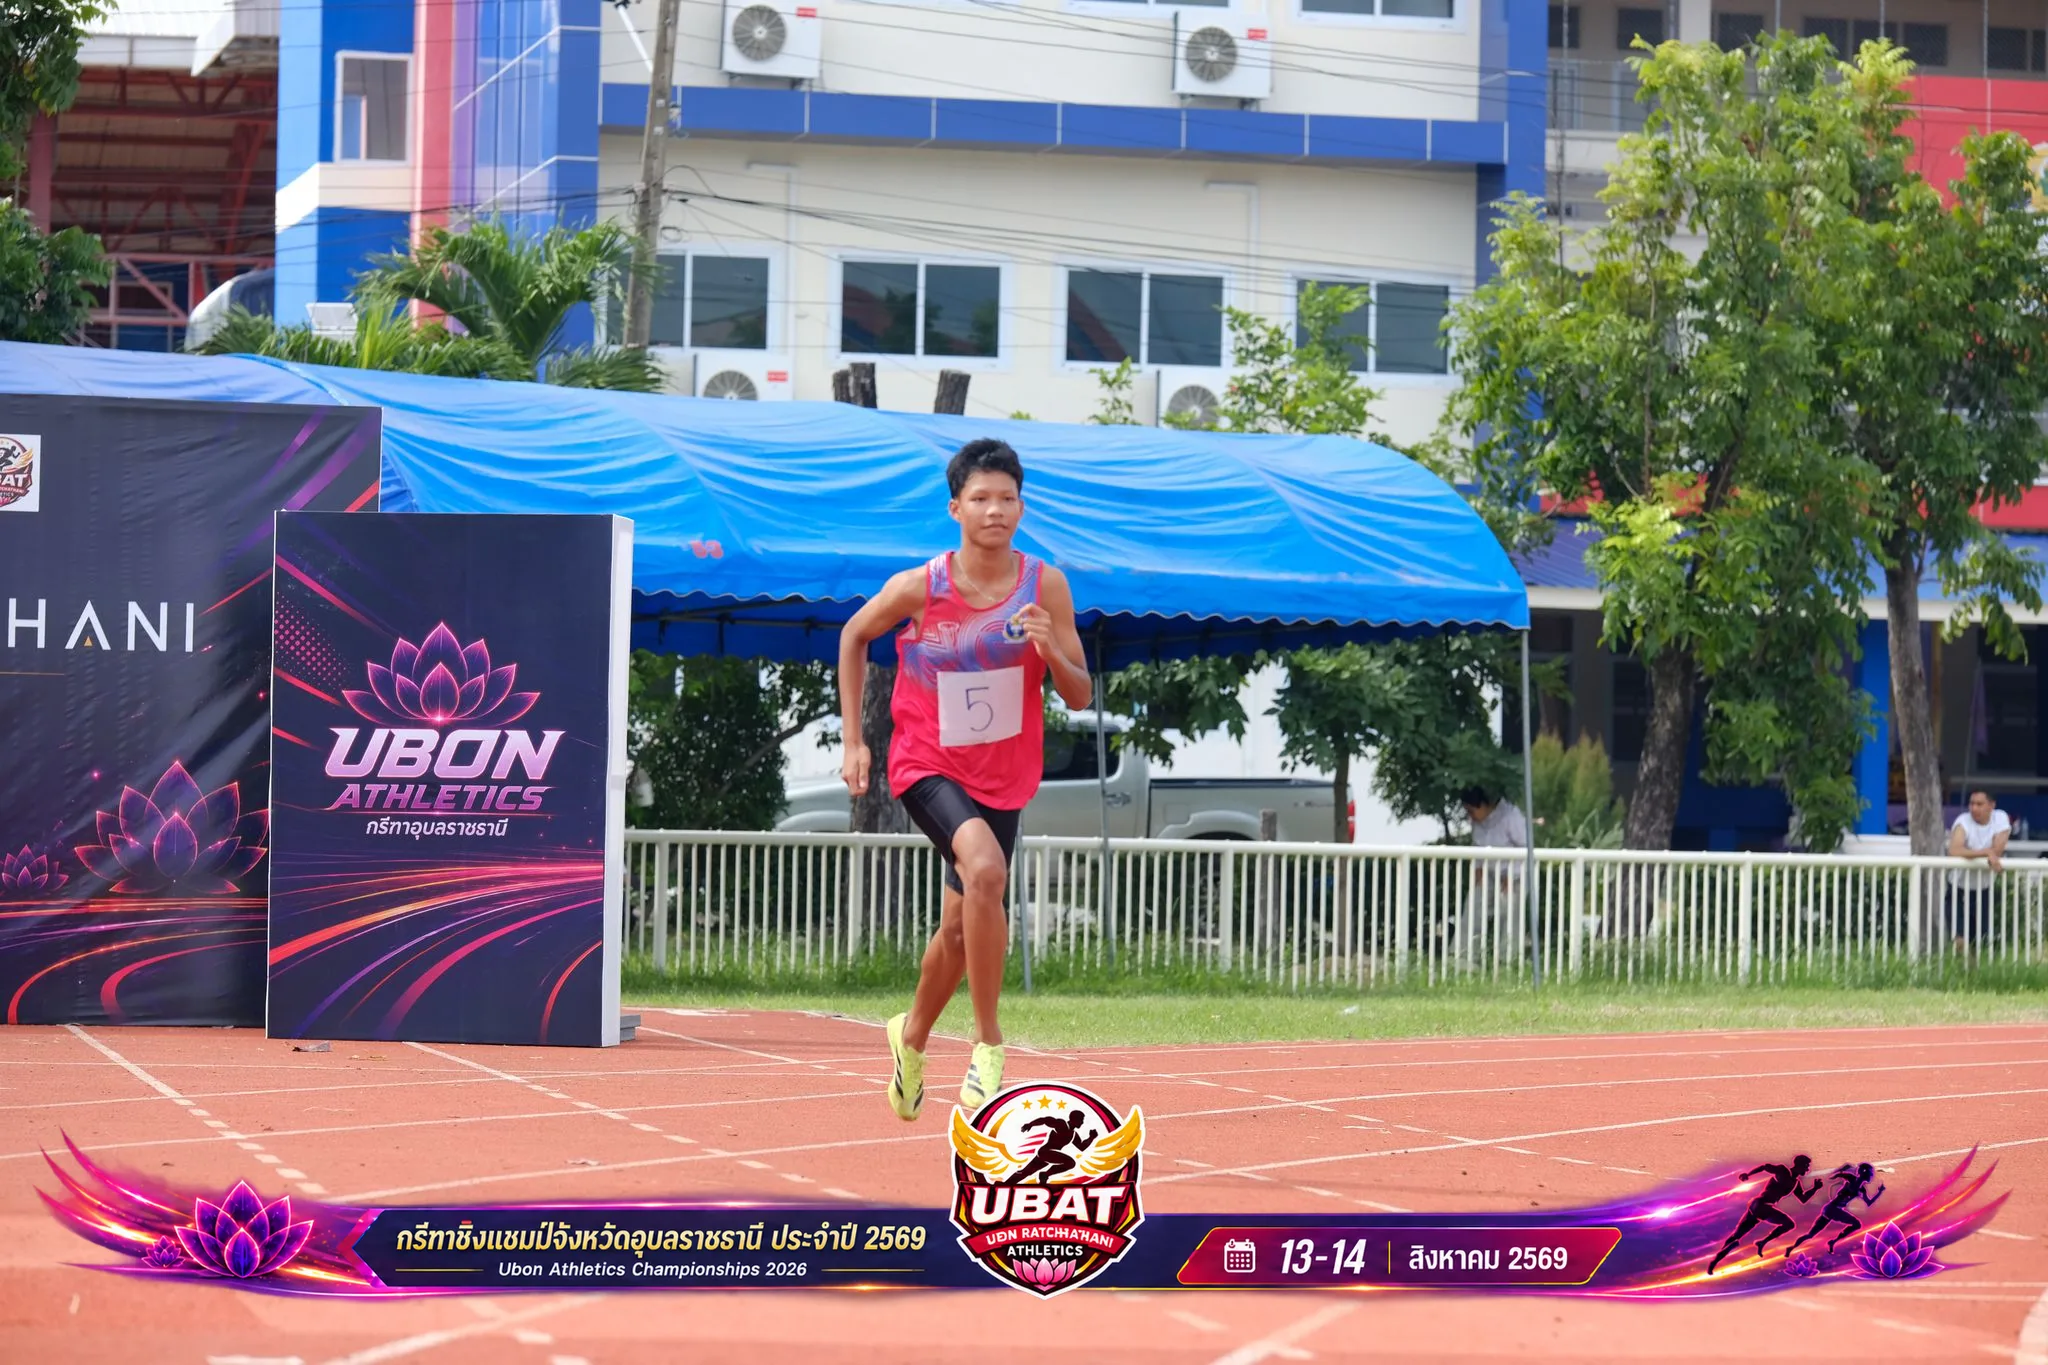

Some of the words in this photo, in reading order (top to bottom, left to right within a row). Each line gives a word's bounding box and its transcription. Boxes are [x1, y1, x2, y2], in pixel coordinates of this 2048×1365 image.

[0, 474, 28, 488] AT
[965, 686, 994, 732] 5
[325, 727, 566, 780] UBON
[330, 783, 553, 811] ATHLETICS
[366, 816, 509, 841] กรีฑาอุบลราชธานี
